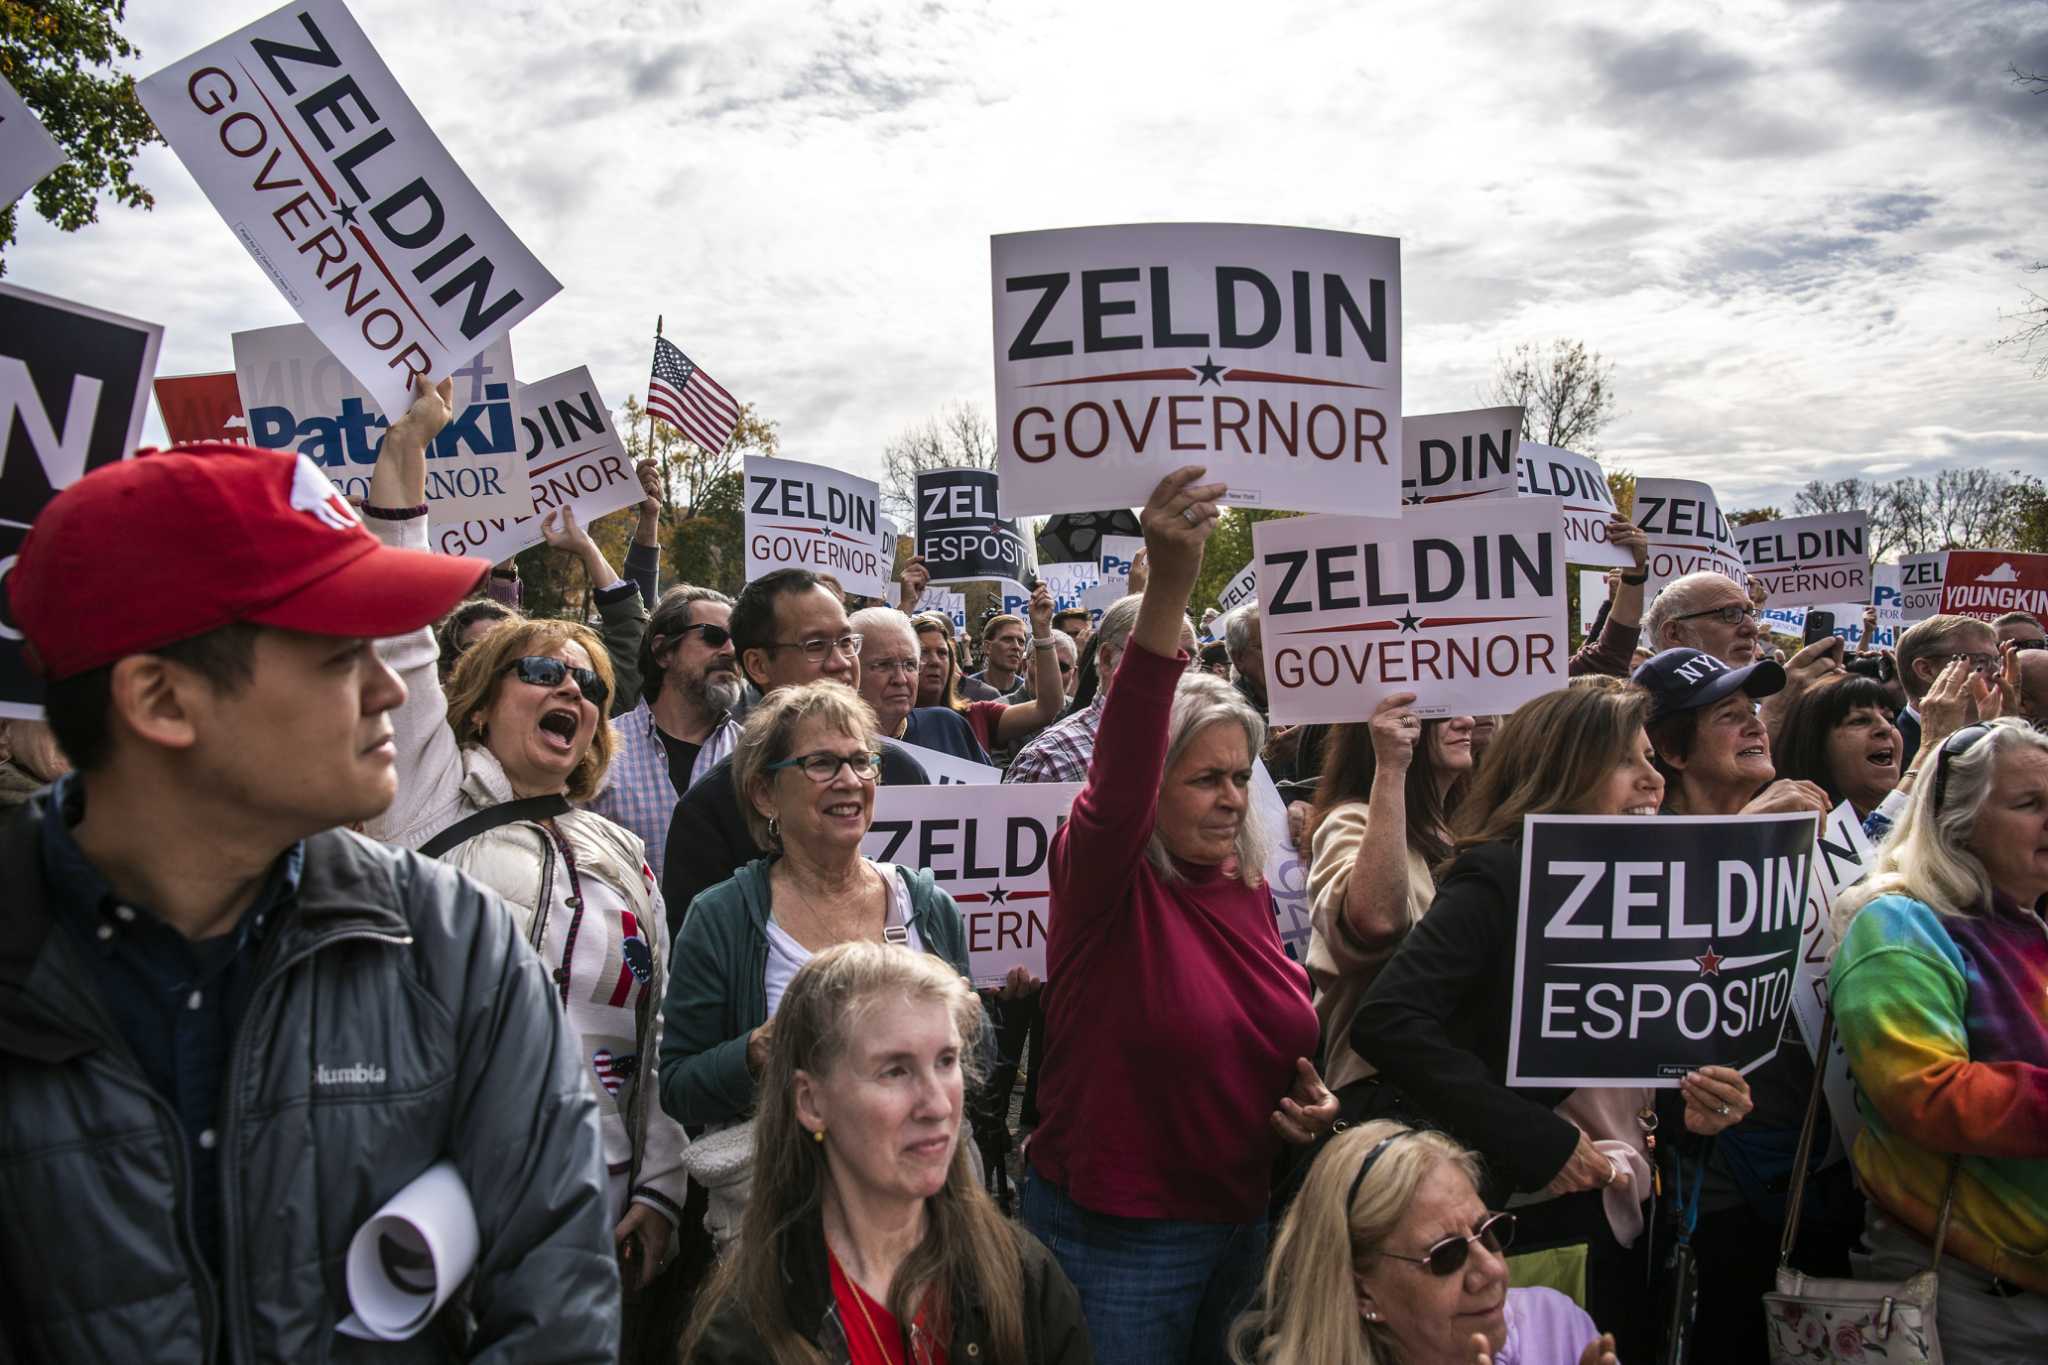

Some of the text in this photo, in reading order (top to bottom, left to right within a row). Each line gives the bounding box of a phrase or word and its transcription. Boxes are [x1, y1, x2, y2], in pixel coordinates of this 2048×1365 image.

[250, 13, 524, 341] ZELDIN
[187, 66, 433, 392] GOVERNOR
[1005, 265, 1387, 363] ZELDIN
[521, 391, 606, 460] DIN
[1012, 395, 1389, 465] GOVERNOR
[1401, 428, 1512, 488] DIN
[1517, 457, 1612, 507] ELDIN
[750, 475, 876, 536] ZELDIN
[923, 484, 1013, 523] ZEL
[1638, 497, 1733, 548] ZELD
[751, 535, 878, 578] GOVERNOR
[924, 535, 1037, 577] ESPOSITO
[1265, 532, 1554, 616] ZELDIN
[1755, 568, 1864, 595] VERNOR
[1902, 561, 1943, 586] ZEL
[1222, 570, 1257, 611] ZELD
[1762, 608, 1804, 628] taki
[1945, 585, 2048, 615] YOUNGKIN
[1274, 633, 1557, 689] GOVERNOR
[867, 816, 1052, 881] ZELD
[1543, 854, 1806, 940] ZELDIN
[1540, 967, 1790, 1041] ESPOSITO
[315, 1063, 388, 1084] lumbia
